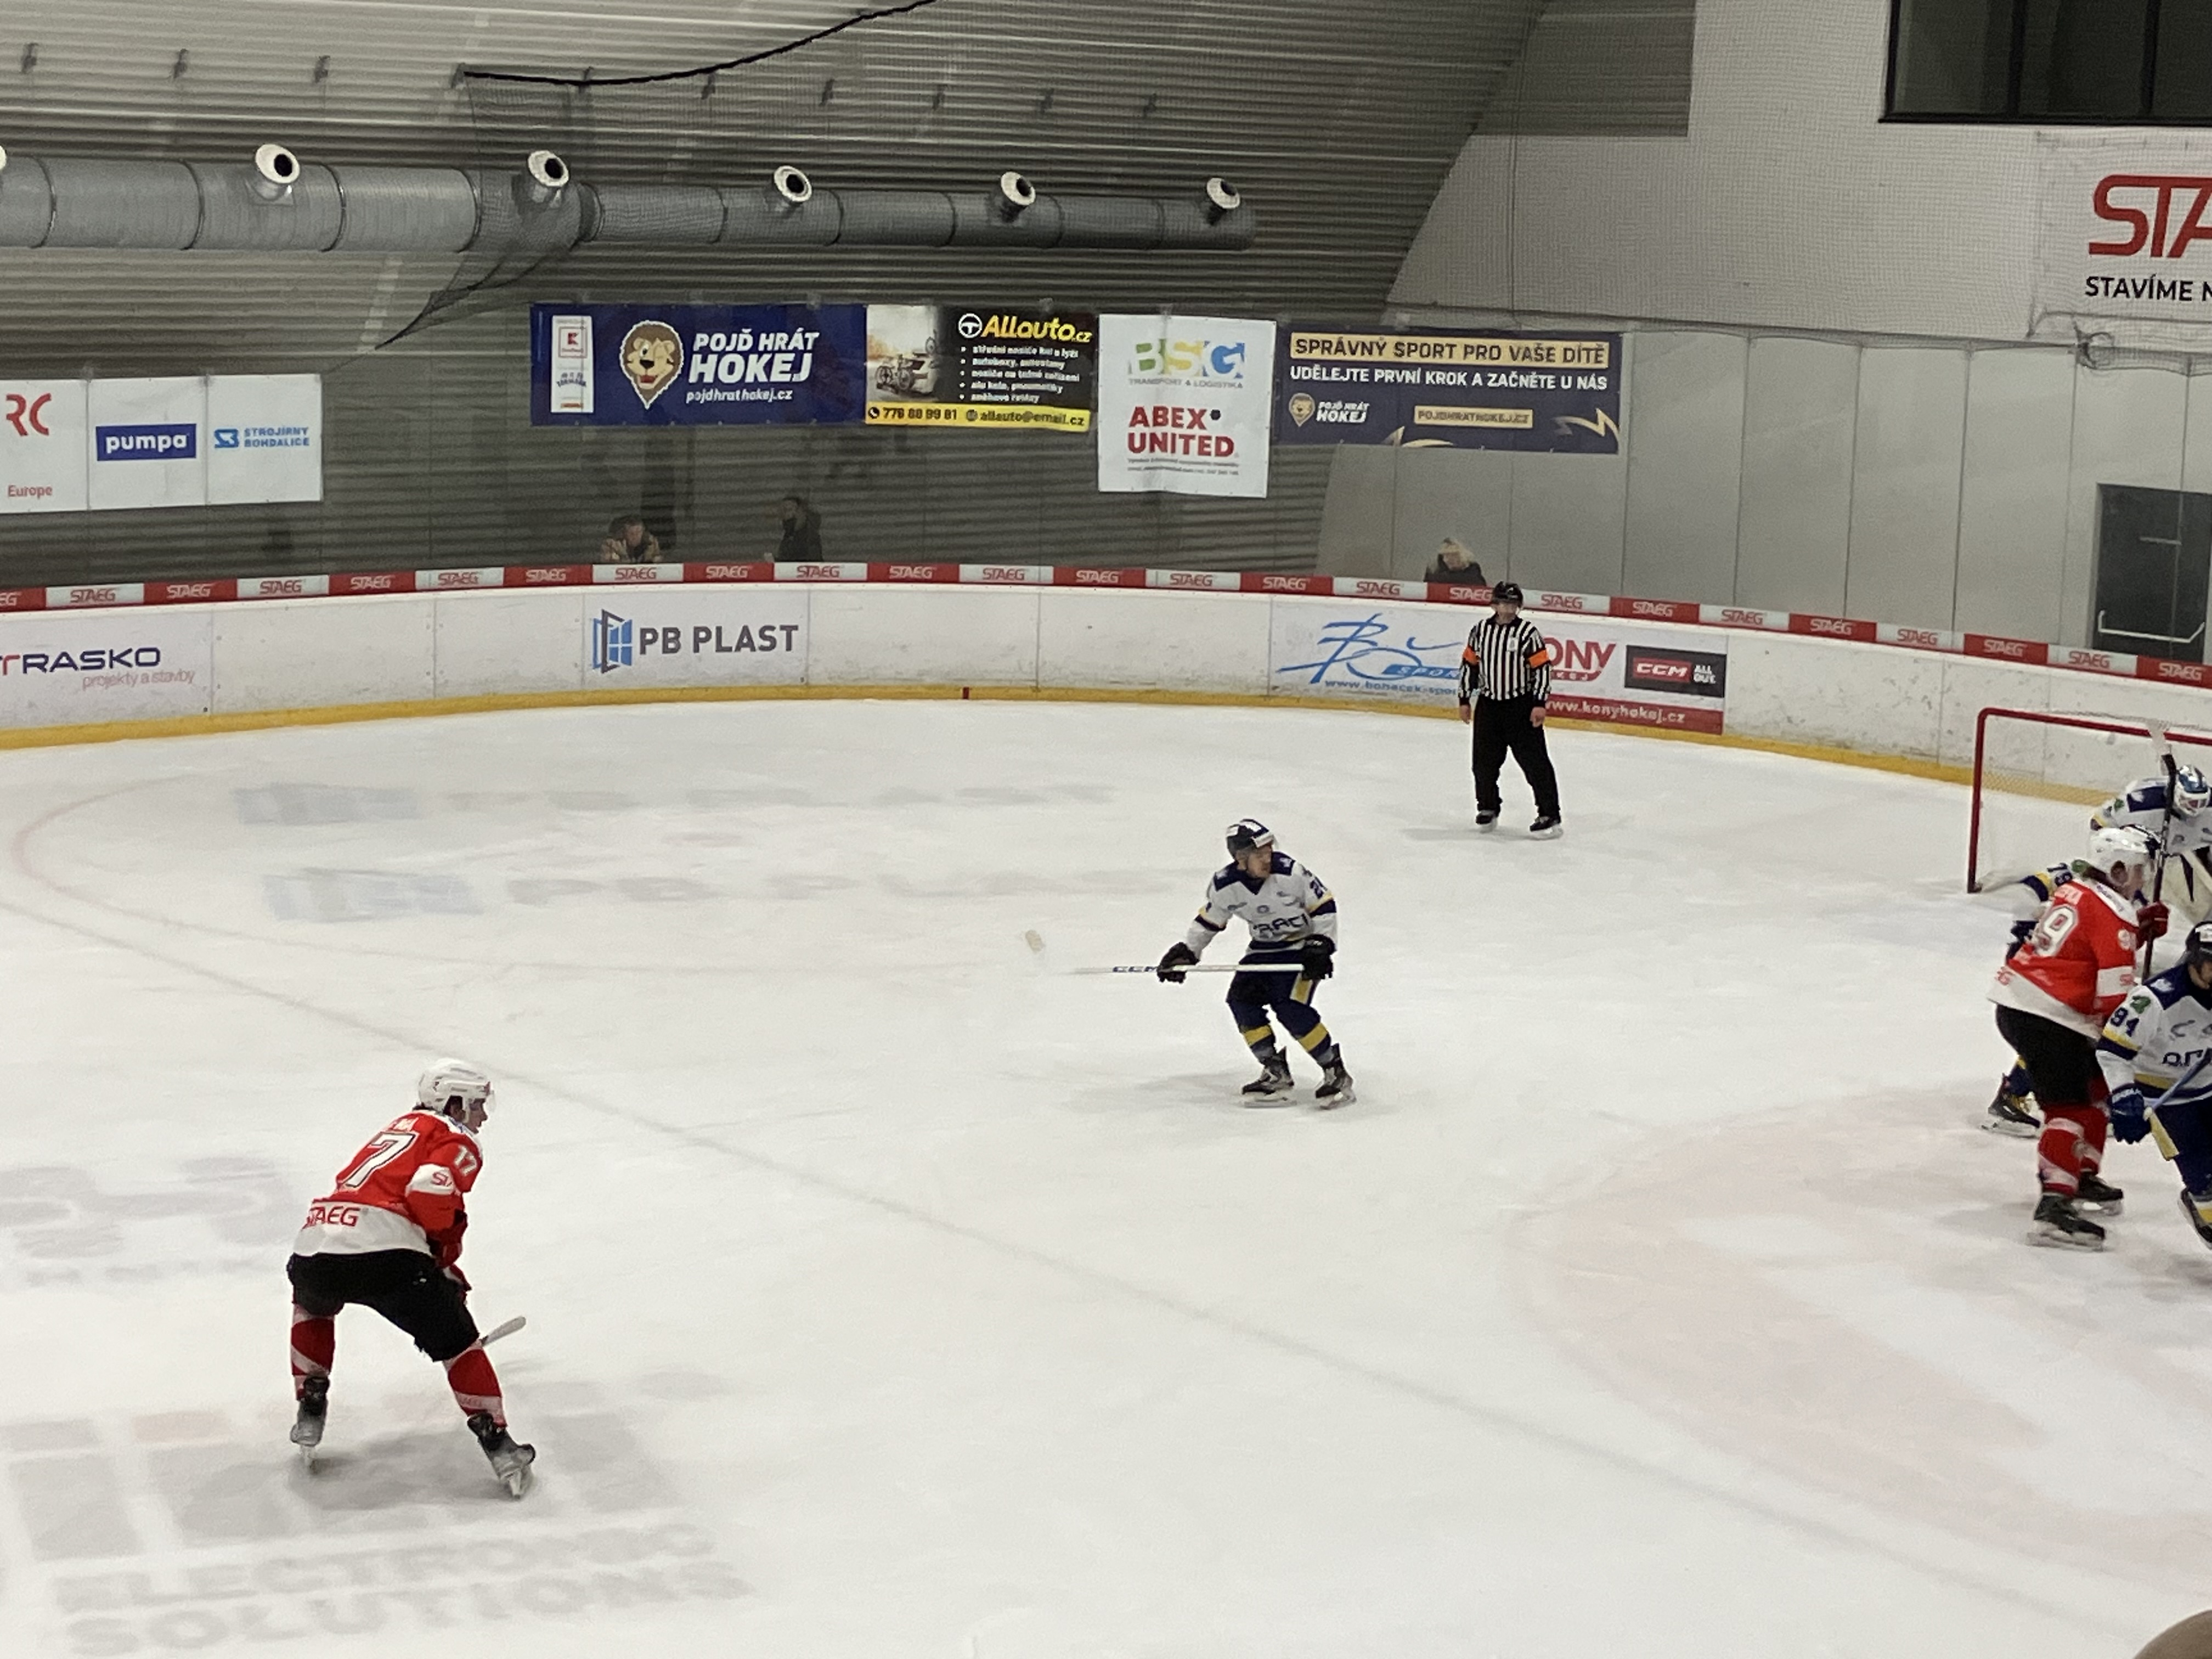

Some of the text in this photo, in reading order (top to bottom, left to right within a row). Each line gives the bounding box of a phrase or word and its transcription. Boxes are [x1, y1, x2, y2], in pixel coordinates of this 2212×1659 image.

[2085, 274, 2193, 301] STAVÍME
[693, 328, 820, 352] POJĎ HRÁT
[1295, 336, 1605, 364] SPRÁVNÝ SPORT PRO VAŠE DÍTĚ
[689, 353, 812, 383] HOKEJ
[1290, 363, 1608, 391] UDĚLEJTE PRVNÍ KROK A ZAČNĚTE U NÁS
[1129, 405, 1207, 430] ABEX
[1316, 410, 1367, 422] HOKEJ
[106, 434, 187, 454] pumpa
[1128, 432, 1234, 457] UNITED
[8, 485, 53, 499] Europe
[437, 572, 478, 586] STAEG
[525, 569, 567, 582] STAEG
[615, 567, 657, 580] STAEG
[706, 566, 748, 578] STAEG
[796, 566, 840, 578] STAEG
[889, 566, 933, 579] STAEG
[982, 568, 1025, 581] STAEG
[1075, 570, 1120, 583] STAEG
[1169, 573, 1213, 586] STAEG
[259, 580, 302, 594] STAEG
[351, 576, 391, 589] STAEG
[1262, 577, 1307, 591] STAEG
[1356, 581, 1401, 596] STAEG
[70, 589, 116, 603] STAEG
[166, 584, 212, 598] STAEG
[1450, 586, 1492, 602] STAEG
[1541, 594, 1583, 609] STAEG
[1632, 601, 1674, 617] STAEG
[1721, 610, 1764, 624] STAEG
[1810, 619, 1853, 635] STAEG
[639, 625, 799, 655] PB PLAST
[1897, 629, 1940, 646] STAEG
[1542, 637, 1617, 670] ONY
[1983, 640, 2025, 657] STAEG
[0, 647, 161, 676] TRASKO
[2069, 651, 2111, 668] STAEG
[1398, 667, 1460, 678] SPOR
[1637, 663, 1688, 678] CCM
[2159, 663, 2203, 681] STAEG
[82, 670, 138, 690] projekty
[453, 1144, 478, 1177] 17
